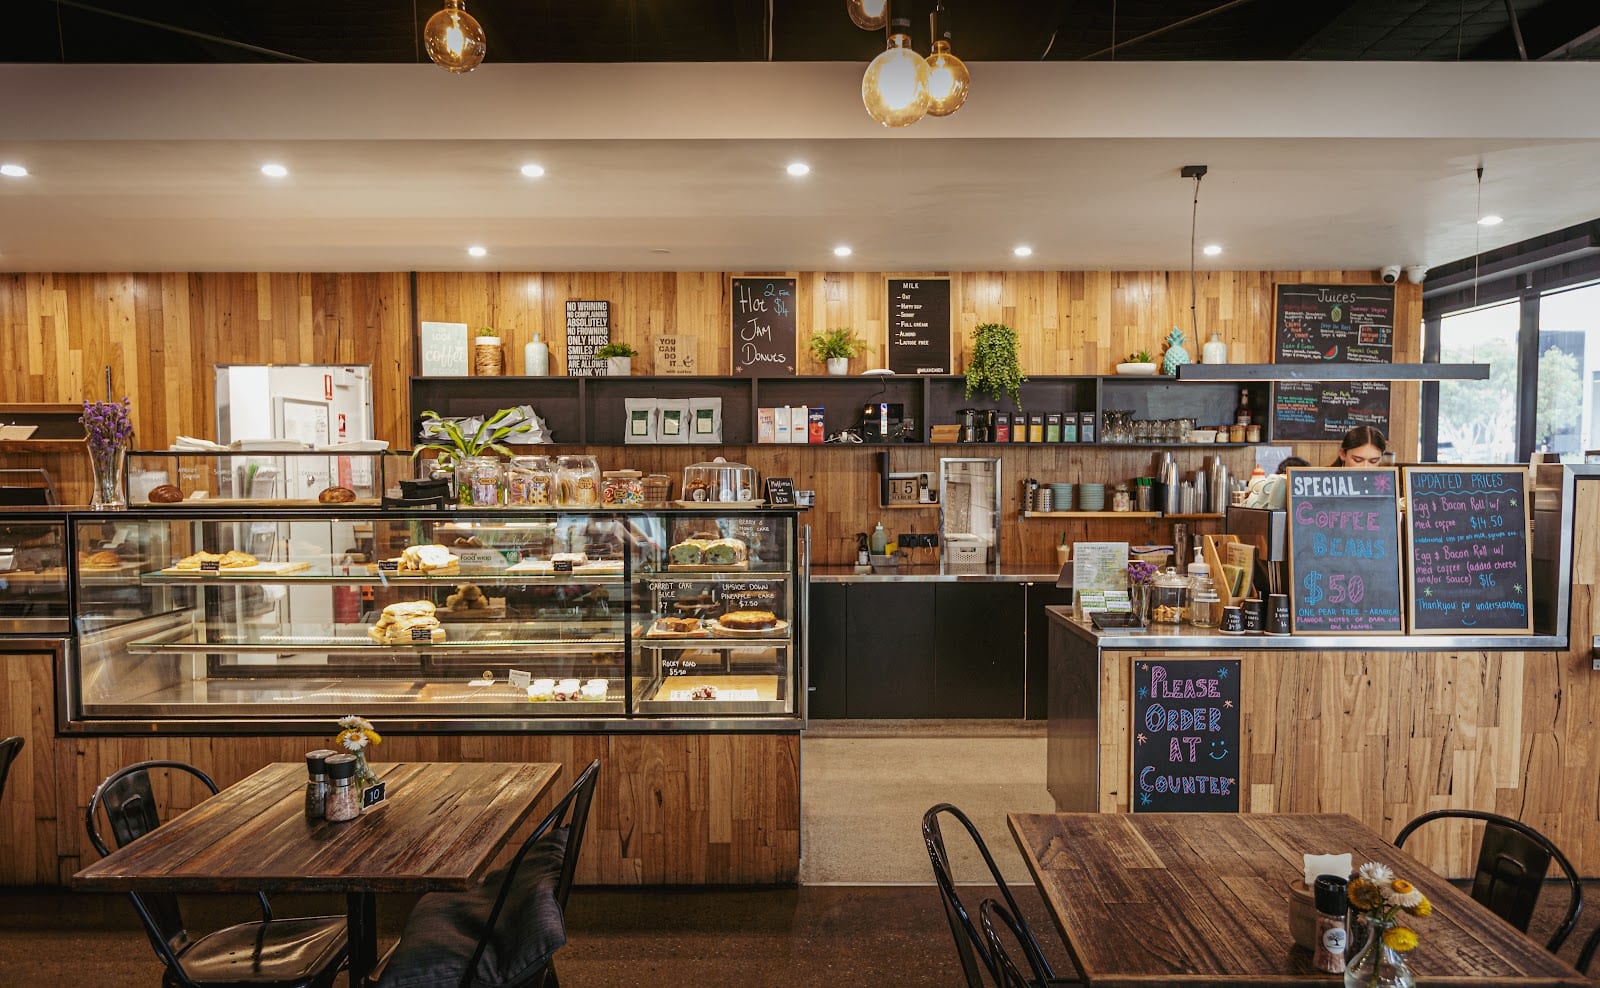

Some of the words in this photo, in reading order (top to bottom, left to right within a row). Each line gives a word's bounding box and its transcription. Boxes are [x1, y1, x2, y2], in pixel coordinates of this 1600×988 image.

[764, 284, 775, 296] 2
[1318, 288, 1356, 304] Juices
[566, 302, 576, 311] NO
[578, 302, 607, 311] WHINING
[774, 297, 789, 317] $4
[567, 318, 608, 326] ABSOLUTELY
[568, 327, 576, 335] NO
[568, 336, 586, 345] ONLY
[588, 336, 608, 345] HUGS
[568, 346, 592, 354] SMILES
[568, 360, 580, 368] ARE
[581, 360, 608, 368] ALLOWED
[1413, 474, 1462, 489] UPDATED
[1472, 474, 1502, 488] PRICES
[1413, 498, 1430, 518] Egg
[1440, 497, 1466, 511] Bacon
[1470, 497, 1485, 511] Roll
[1415, 520, 1431, 529] med
[1435, 520, 1456, 533] coffee
[1470, 515, 1503, 530] $14.50
[1415, 550, 1431, 565] Egg
[1443, 545, 1469, 560] Bacon
[1473, 544, 1487, 557] Roll
[1416, 564, 1433, 574] med
[1437, 564, 1461, 577] coffee
[1466, 562, 1492, 574] (added
[1495, 560, 1517, 570] cheese
[1417, 575, 1441, 584] and/or
[1446, 574, 1472, 585] sauce)
[1479, 573, 1496, 588] $16
[1298, 608, 1315, 616] ONE
[1417, 598, 1457, 615] Thankyou
[1461, 600, 1470, 612] for
[1476, 600, 1525, 616] understanding
[1169, 736, 1202, 762] AT
[369, 788, 380, 803] 10
